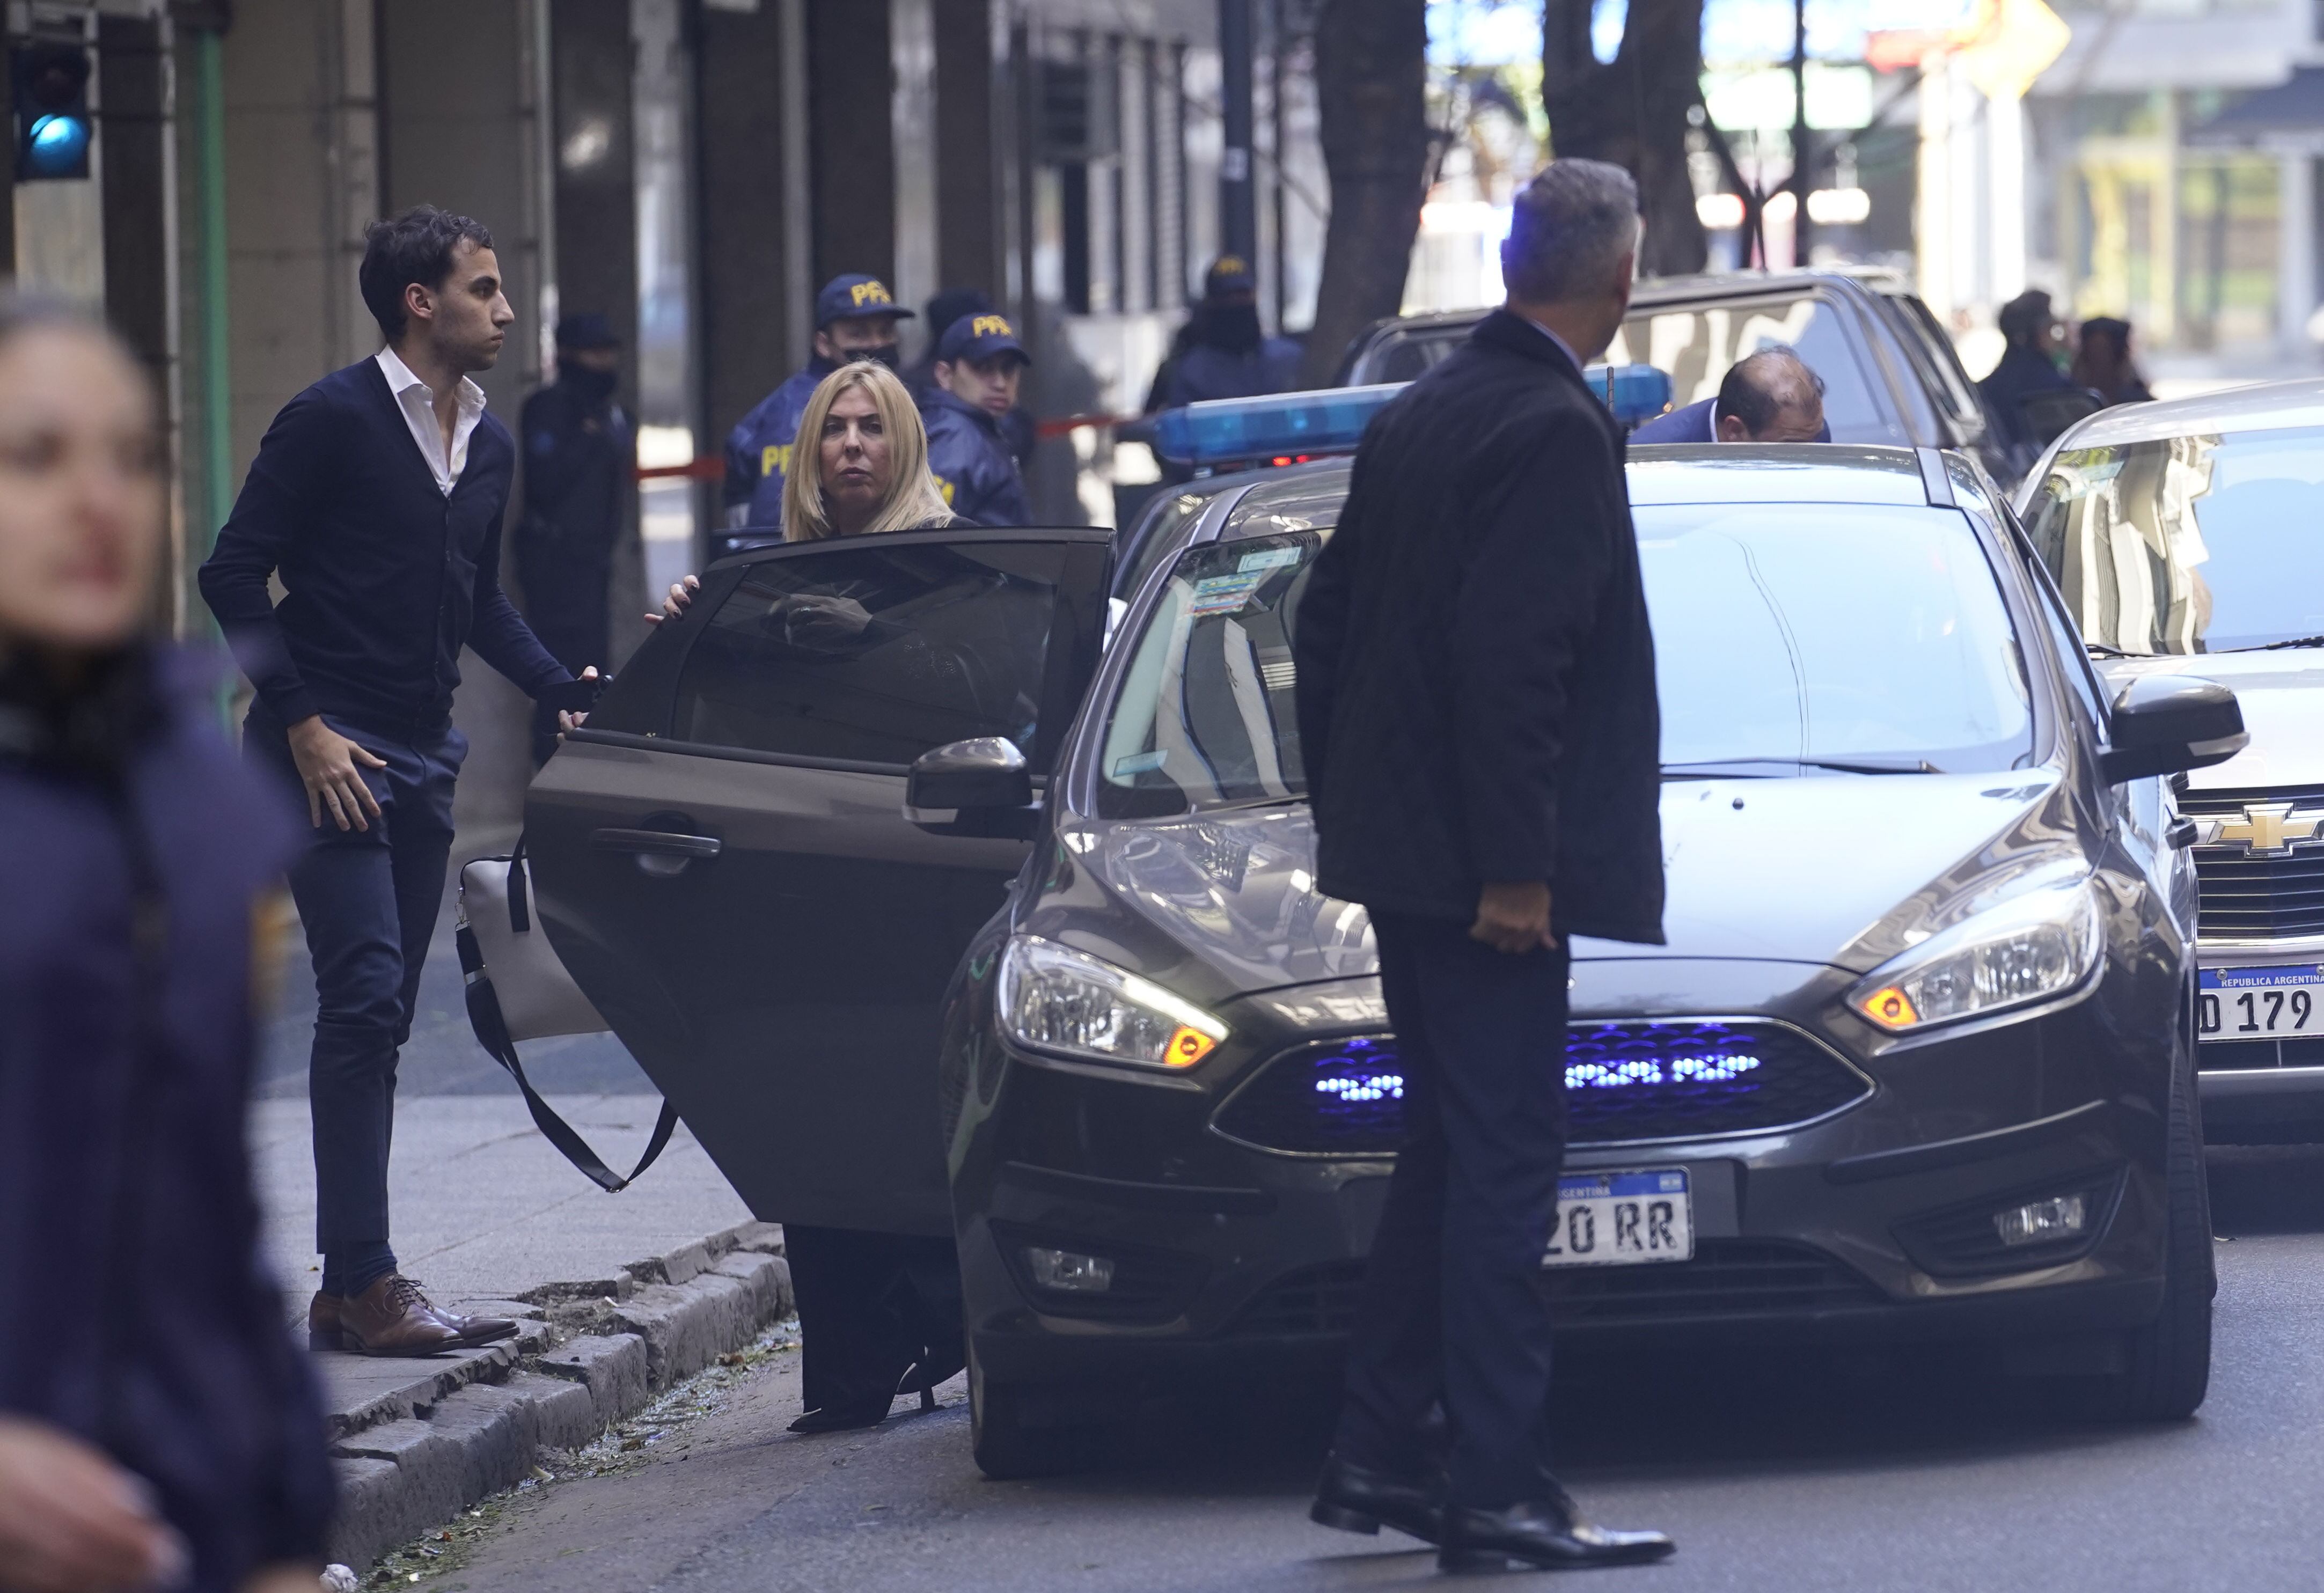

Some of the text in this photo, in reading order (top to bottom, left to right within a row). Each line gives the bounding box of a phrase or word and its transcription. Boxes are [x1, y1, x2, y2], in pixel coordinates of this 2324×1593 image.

[2222, 978, 2271, 987] REPUBLICA
[2238, 990, 2312, 1031] 179
[1558, 1185, 1611, 1200] GENTINA
[1614, 1201, 1677, 1251] RR
